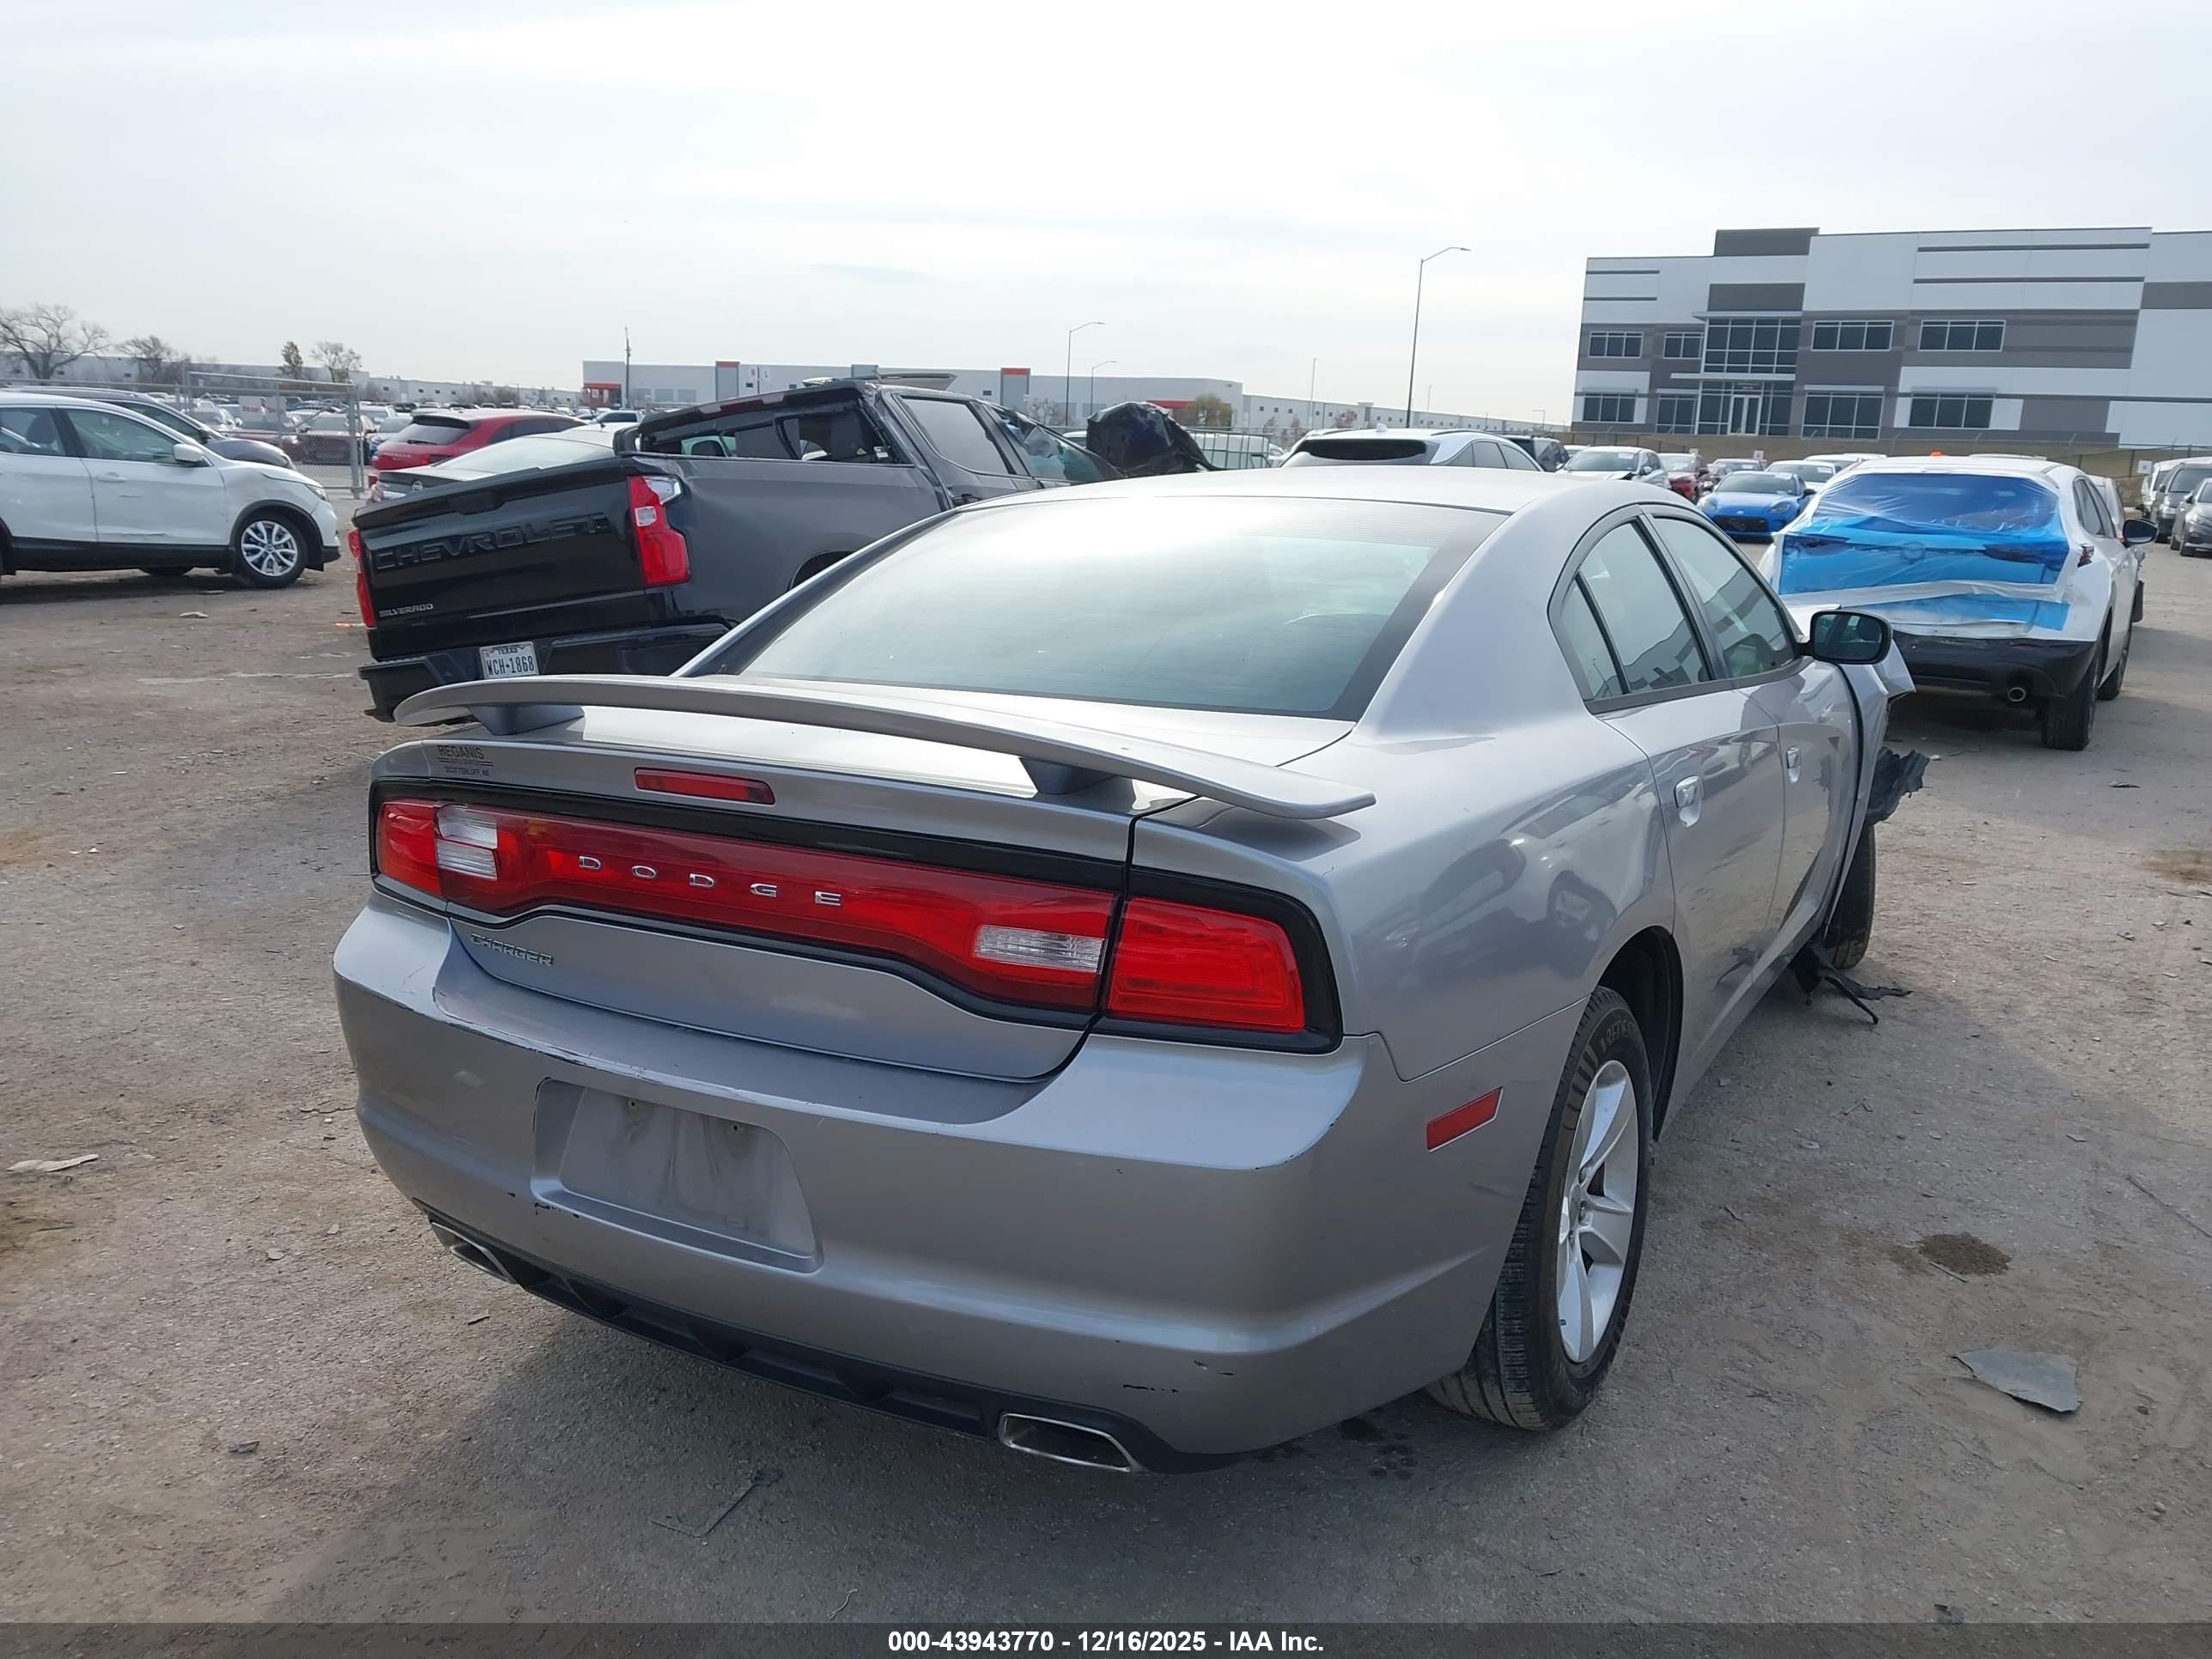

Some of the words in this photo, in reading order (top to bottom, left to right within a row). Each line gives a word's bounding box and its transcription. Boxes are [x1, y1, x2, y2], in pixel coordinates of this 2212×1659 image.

[376, 513, 609, 570] CHEVROLET
[379, 603, 434, 617] SILVERADO
[579, 855, 842, 906] DODGE
[471, 933, 553, 967] CHARGER
